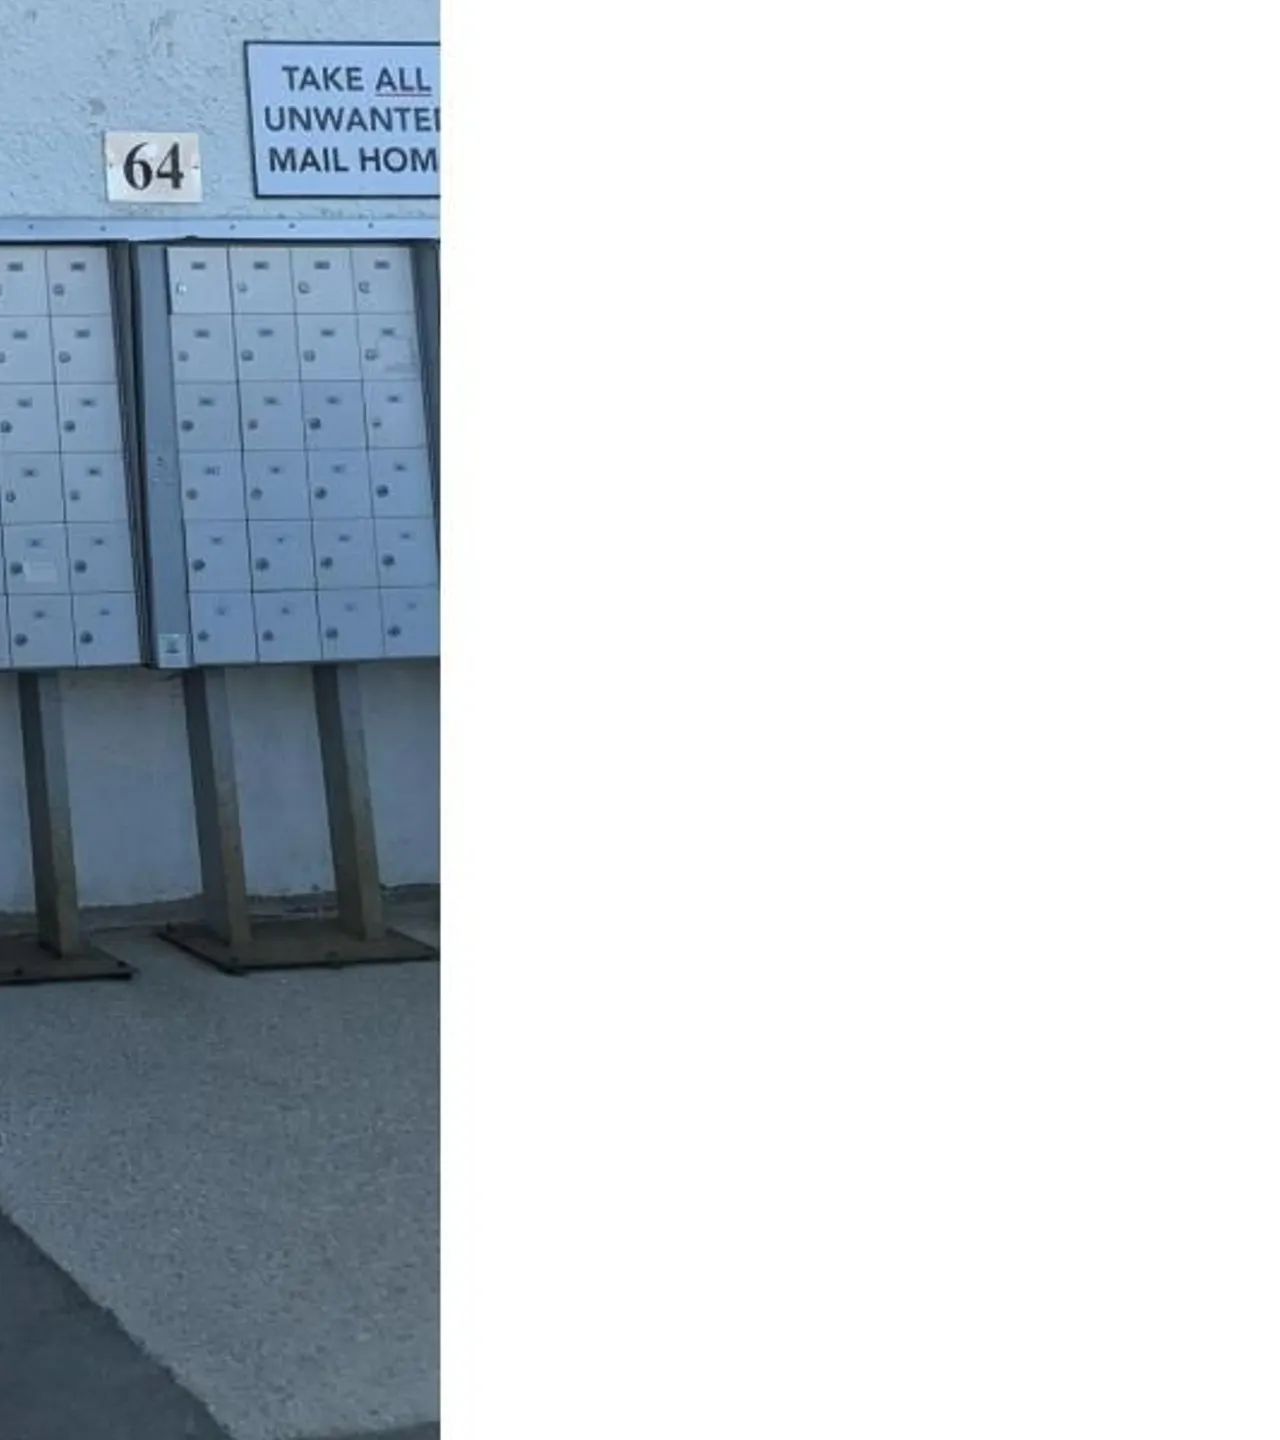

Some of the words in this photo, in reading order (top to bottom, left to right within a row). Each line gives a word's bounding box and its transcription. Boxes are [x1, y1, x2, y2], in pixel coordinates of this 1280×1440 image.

[281, 65, 364, 92] TAKE
[375, 66, 432, 92] ALL
[264, 105, 440, 133] UNWANTE
[123, 142, 184, 190] 64
[268, 146, 350, 173] MAIL
